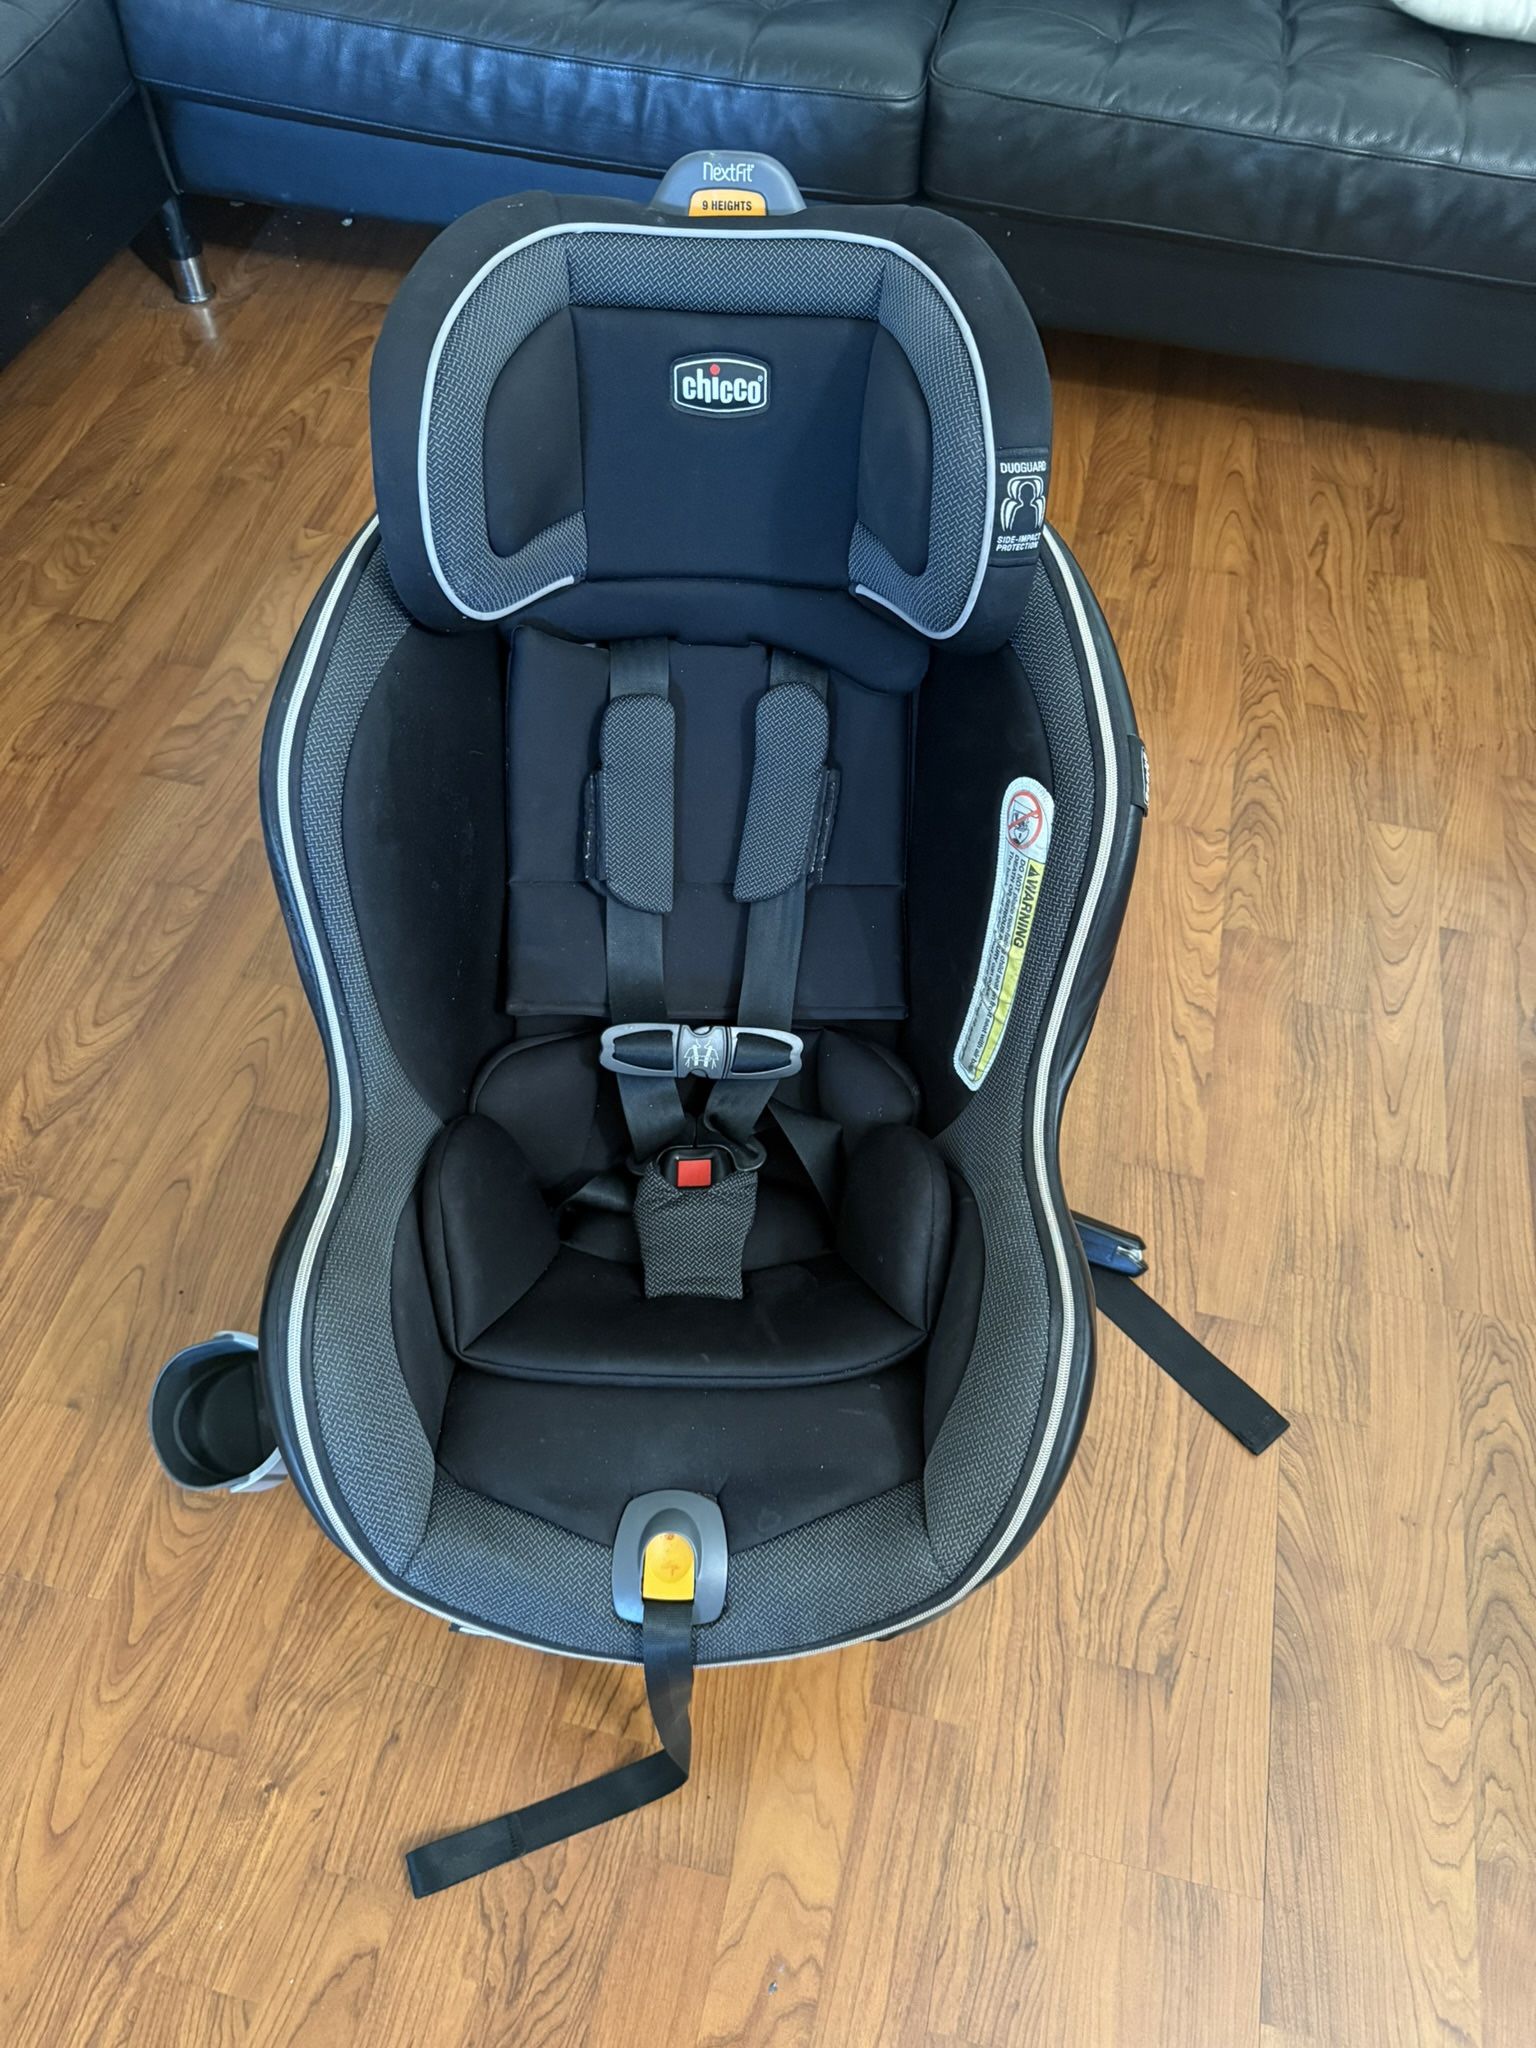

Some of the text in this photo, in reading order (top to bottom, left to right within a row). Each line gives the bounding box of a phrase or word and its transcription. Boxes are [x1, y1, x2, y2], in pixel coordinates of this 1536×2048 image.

[703, 162, 754, 182] NextFit
[702, 201, 752, 211] 9 HEIGHTS
[1000, 461, 1047, 474] DUOGUARD
[997, 533, 1041, 544] SIDE-IMPACT
[995, 541, 1039, 552] PROTECTION
[1011, 854, 1019, 883] DEATH
[1020, 859, 1026, 872] DO
[1014, 873, 1023, 892] NOT
[1014, 879, 1037, 948] WARNING
